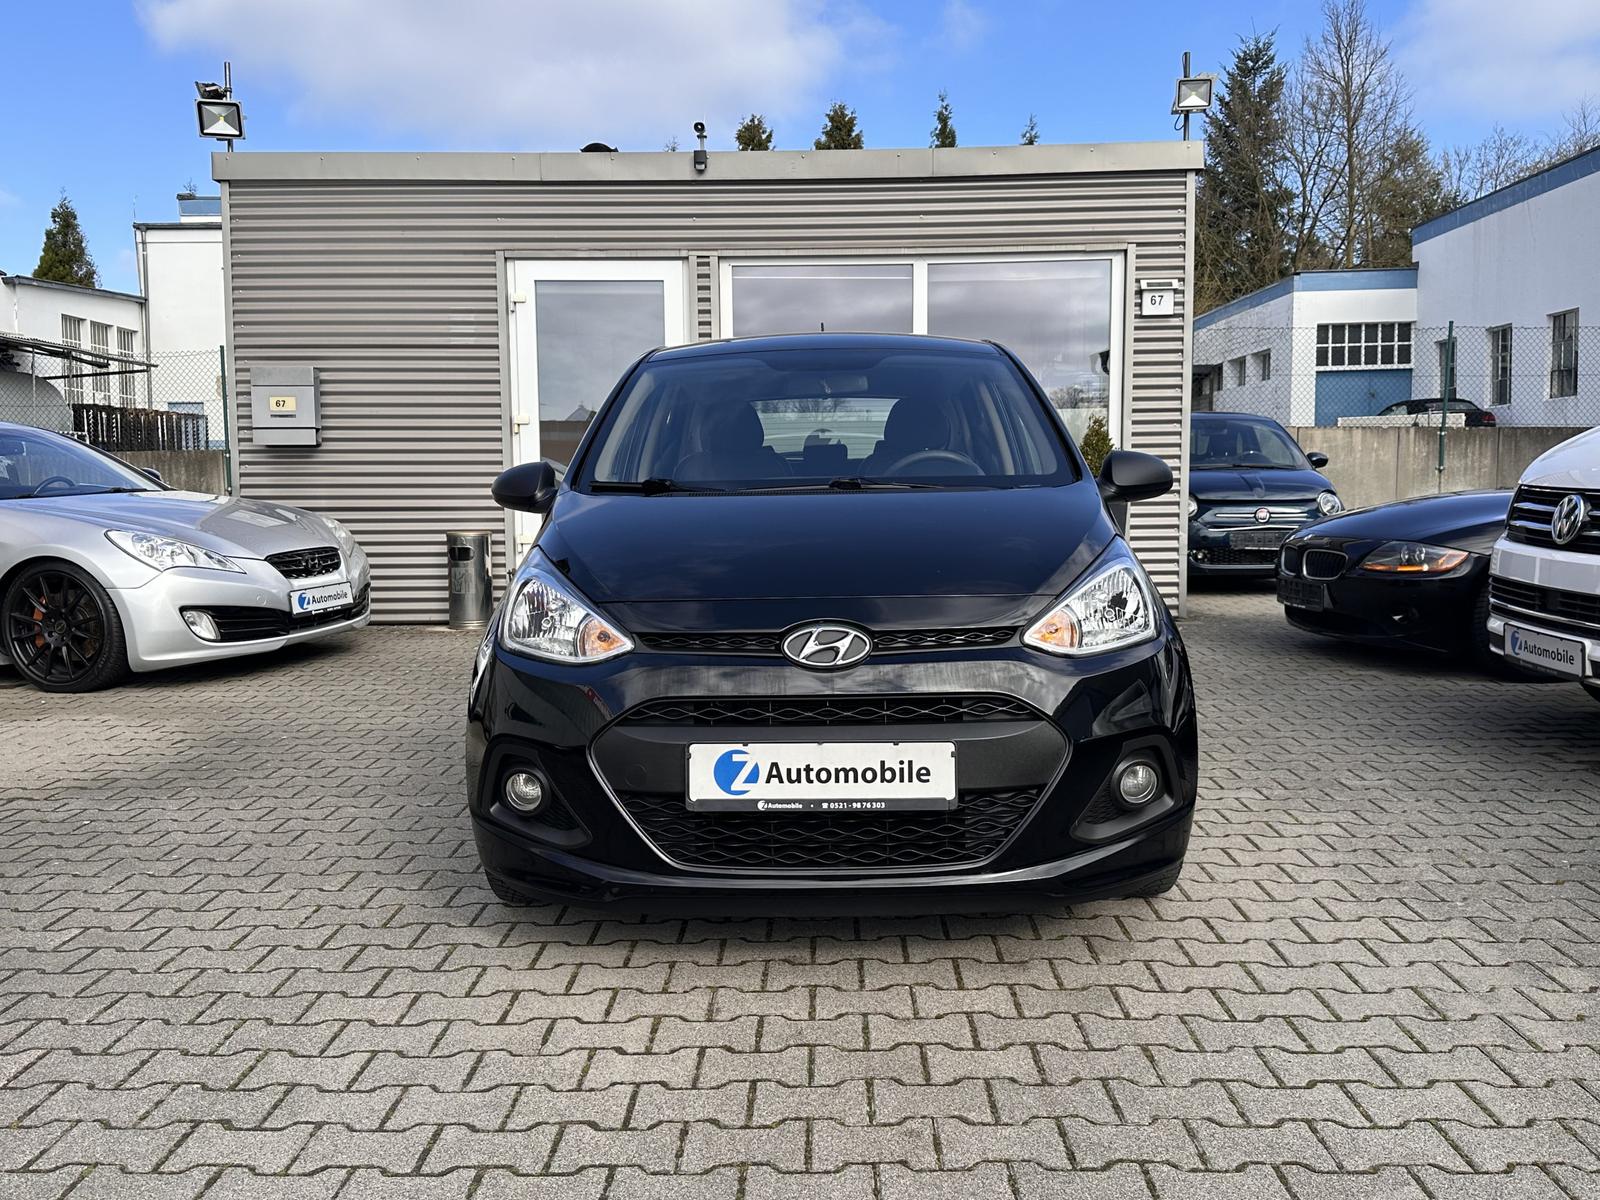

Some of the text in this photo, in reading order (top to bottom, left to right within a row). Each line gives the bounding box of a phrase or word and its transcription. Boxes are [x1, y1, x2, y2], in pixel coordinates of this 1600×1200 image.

[1150, 294, 1164, 306] 67
[275, 399, 286, 408] 67
[311, 590, 348, 605] Automobile
[1523, 639, 1575, 665] Automobile
[765, 759, 931, 785] Automobile
